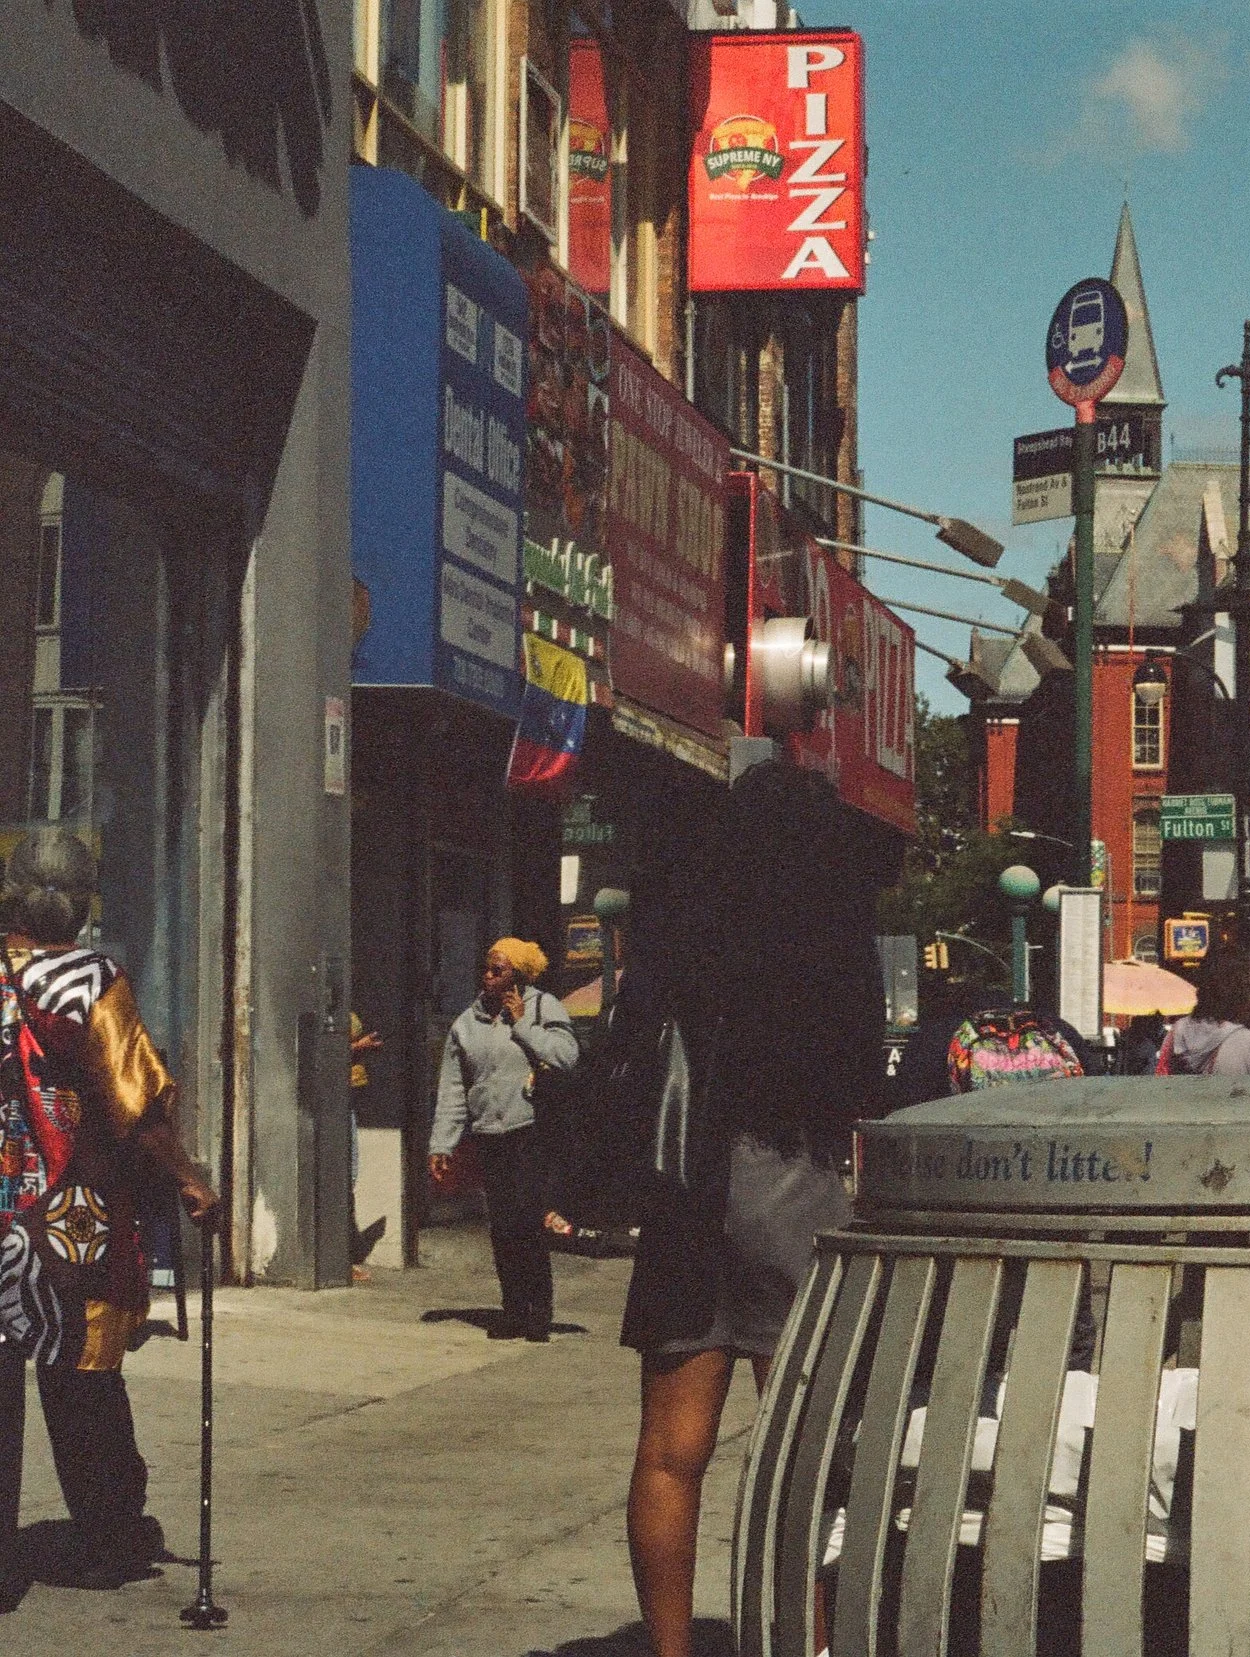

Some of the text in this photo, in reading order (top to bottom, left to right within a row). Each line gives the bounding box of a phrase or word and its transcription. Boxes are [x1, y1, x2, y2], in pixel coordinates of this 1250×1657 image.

[707, 149, 761, 170] SUPREME
[762, 153, 781, 168] NY
[780, 44, 851, 280] PIZZA
[444, 384, 484, 473] Dental
[618, 361, 642, 416] ONE
[645, 384, 672, 440] STOP
[1097, 423, 1131, 453] B44
[609, 417, 668, 539] PAWN
[673, 469, 726, 578] SHOP
[1164, 819, 1230, 838] Fulton St
[956, 1139, 1032, 1182] don't
[1046, 1140, 1153, 1183] litte!
